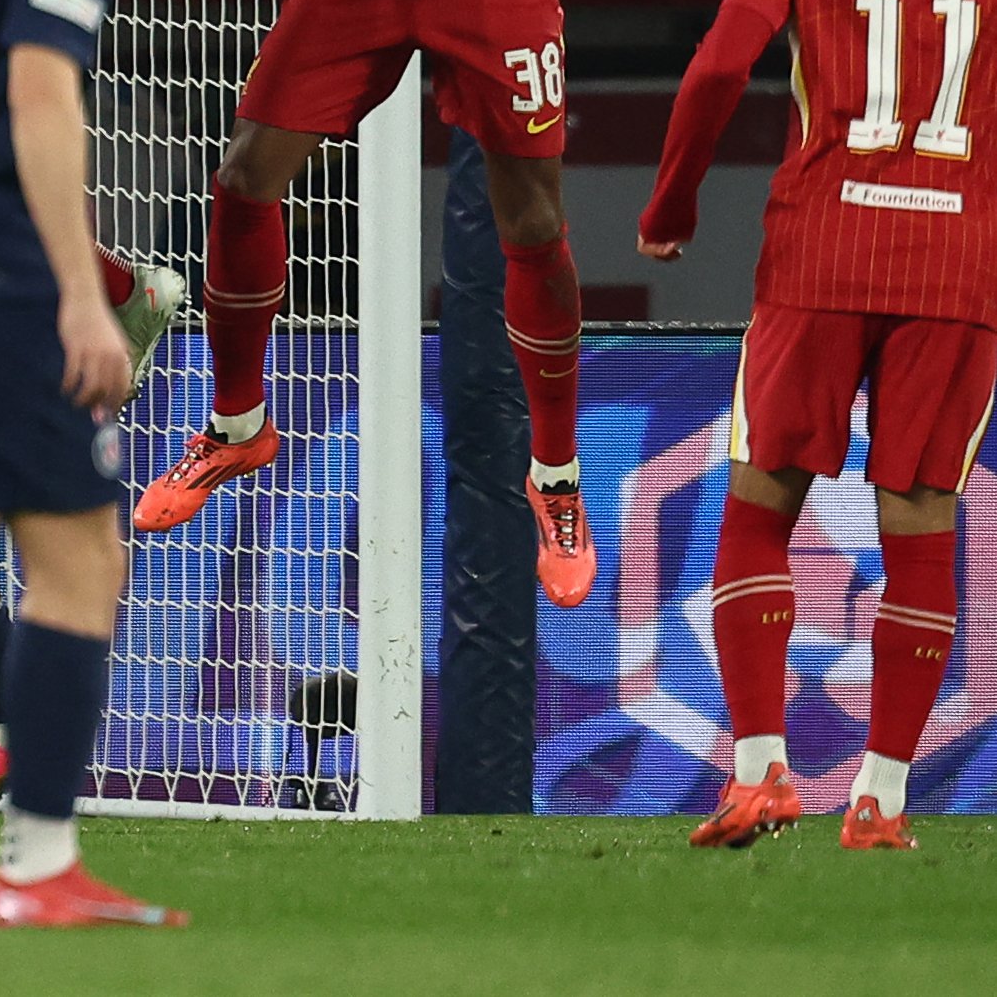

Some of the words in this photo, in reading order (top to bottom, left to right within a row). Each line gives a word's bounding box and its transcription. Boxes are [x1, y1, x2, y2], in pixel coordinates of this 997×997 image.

[504, 41, 563, 112] 38
[863, 188, 957, 210] Foundation
[762, 611, 790, 624] LFC
[915, 647, 943, 661] LFC
